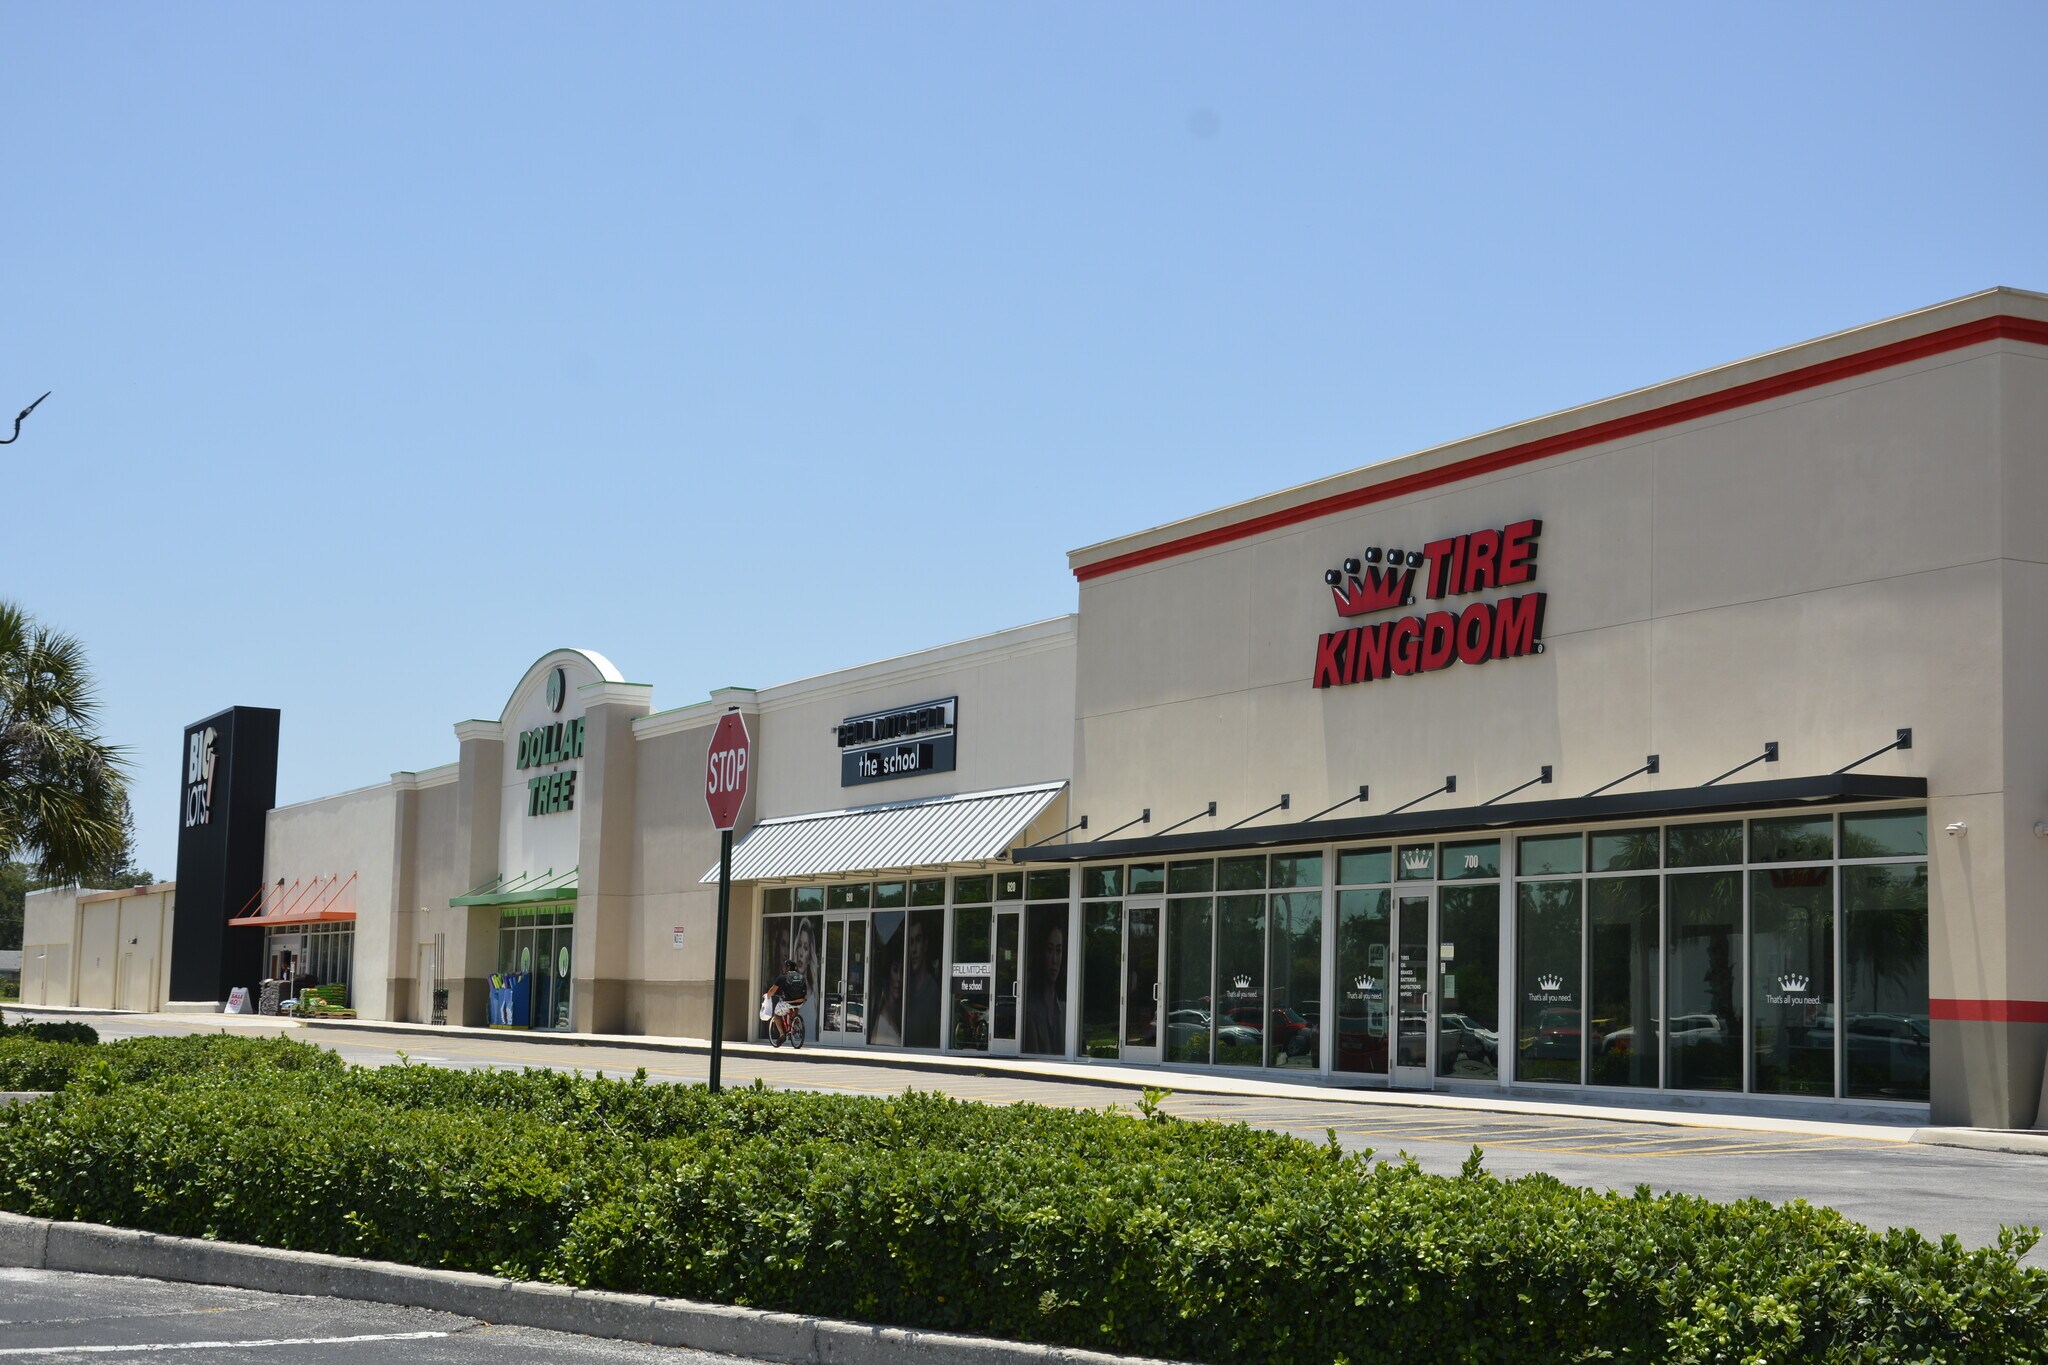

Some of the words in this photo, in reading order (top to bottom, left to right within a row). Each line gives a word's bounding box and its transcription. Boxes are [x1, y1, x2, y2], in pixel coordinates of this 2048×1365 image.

[1423, 519, 1542, 600] TIRE
[1313, 592, 1547, 689] KINGDOM
[516, 716, 586, 770] DOLLAR
[838, 720, 874, 747] PAUL
[873, 706, 945, 742] MITCHELL
[188, 726, 217, 785] BIG
[708, 747, 746, 794] STOP
[859, 751, 878, 777] the
[883, 743, 920, 773] school
[528, 770, 577, 817] TREE
[1464, 854, 1479, 869] 700
[1007, 881, 1016, 892] 620
[953, 965, 966, 974] PAUL
[968, 979, 983, 990] school
[1363, 993, 1371, 1001] you
[1528, 992, 1541, 1002] That's
[1548, 995, 1558, 1004] you
[1766, 994, 1783, 1004] That's
[1783, 994, 1791, 1004] all
[1791, 997, 1803, 1007] you
[1803, 995, 1821, 1005] need.
